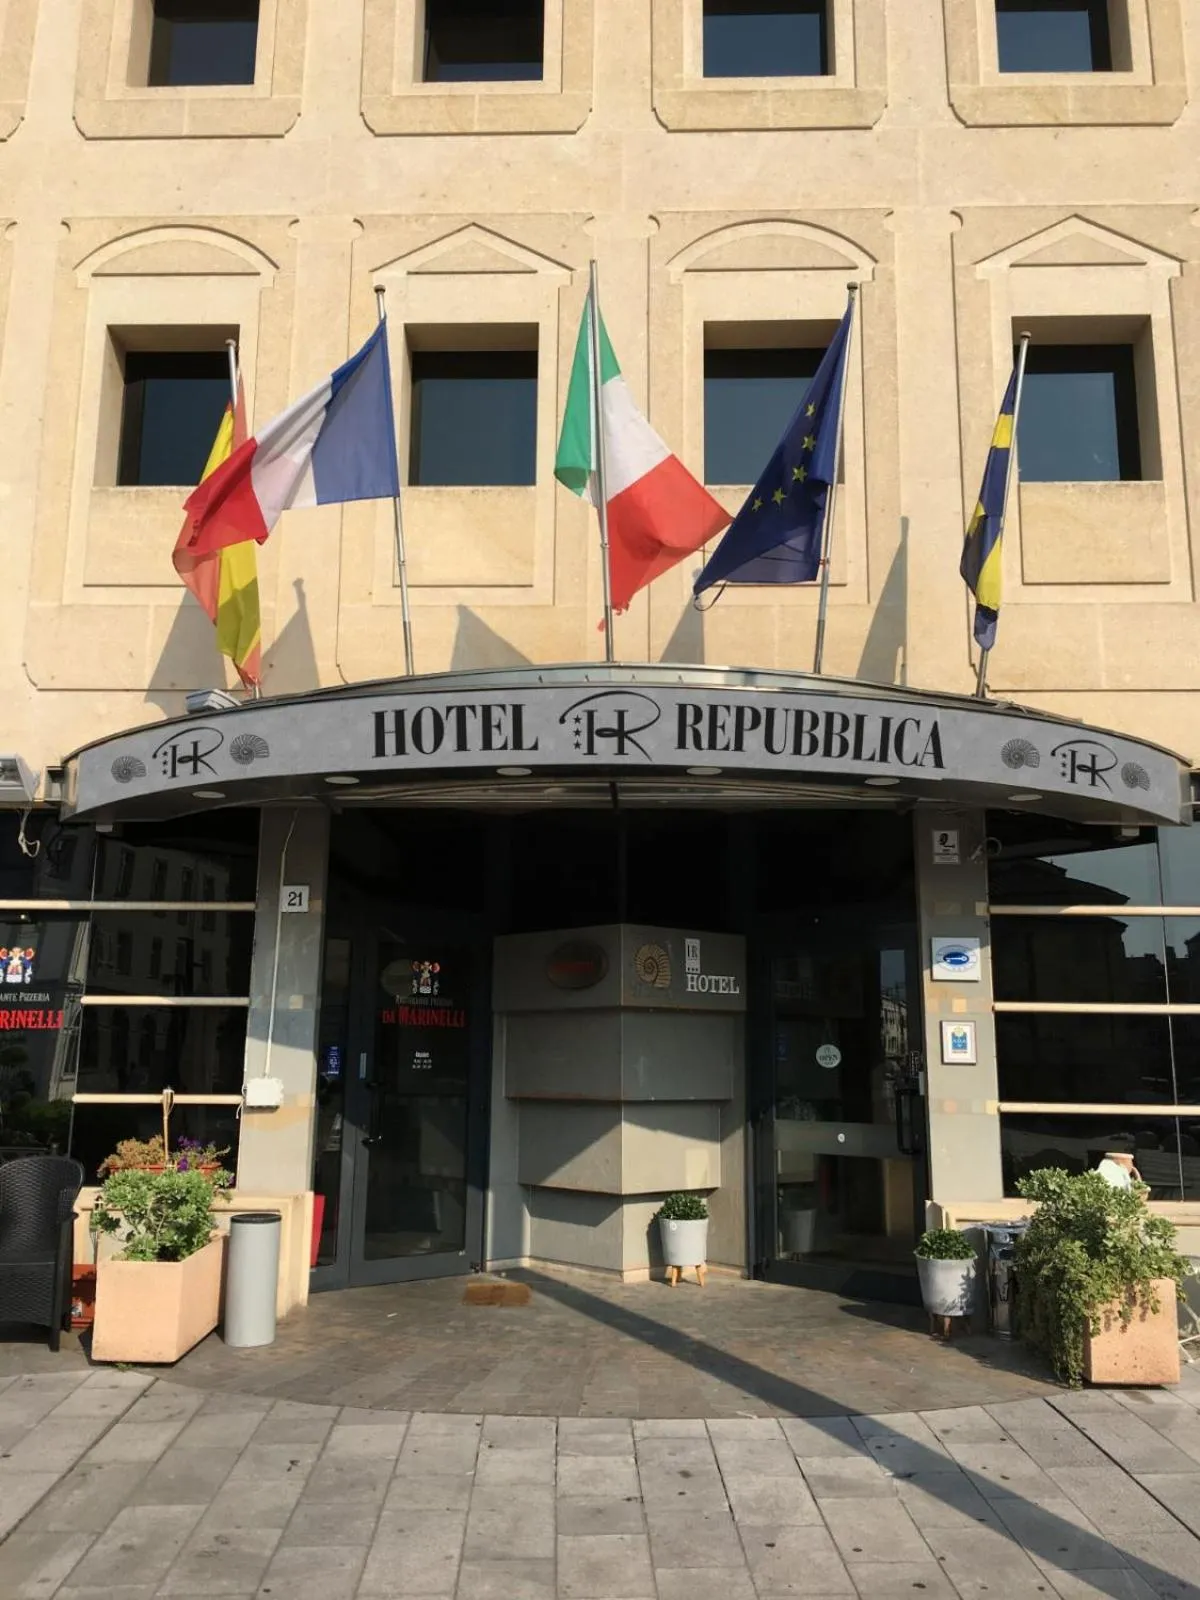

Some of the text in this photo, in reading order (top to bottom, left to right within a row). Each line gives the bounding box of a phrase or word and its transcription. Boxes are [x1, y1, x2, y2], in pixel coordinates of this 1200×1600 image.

[372, 703, 539, 758] HOTEL
[675, 702, 946, 769] REPUBBLICA
[287, 891, 303, 907] 21
[686, 973, 740, 994] HOTEL
[398, 1005, 466, 1028] MARINELLI
